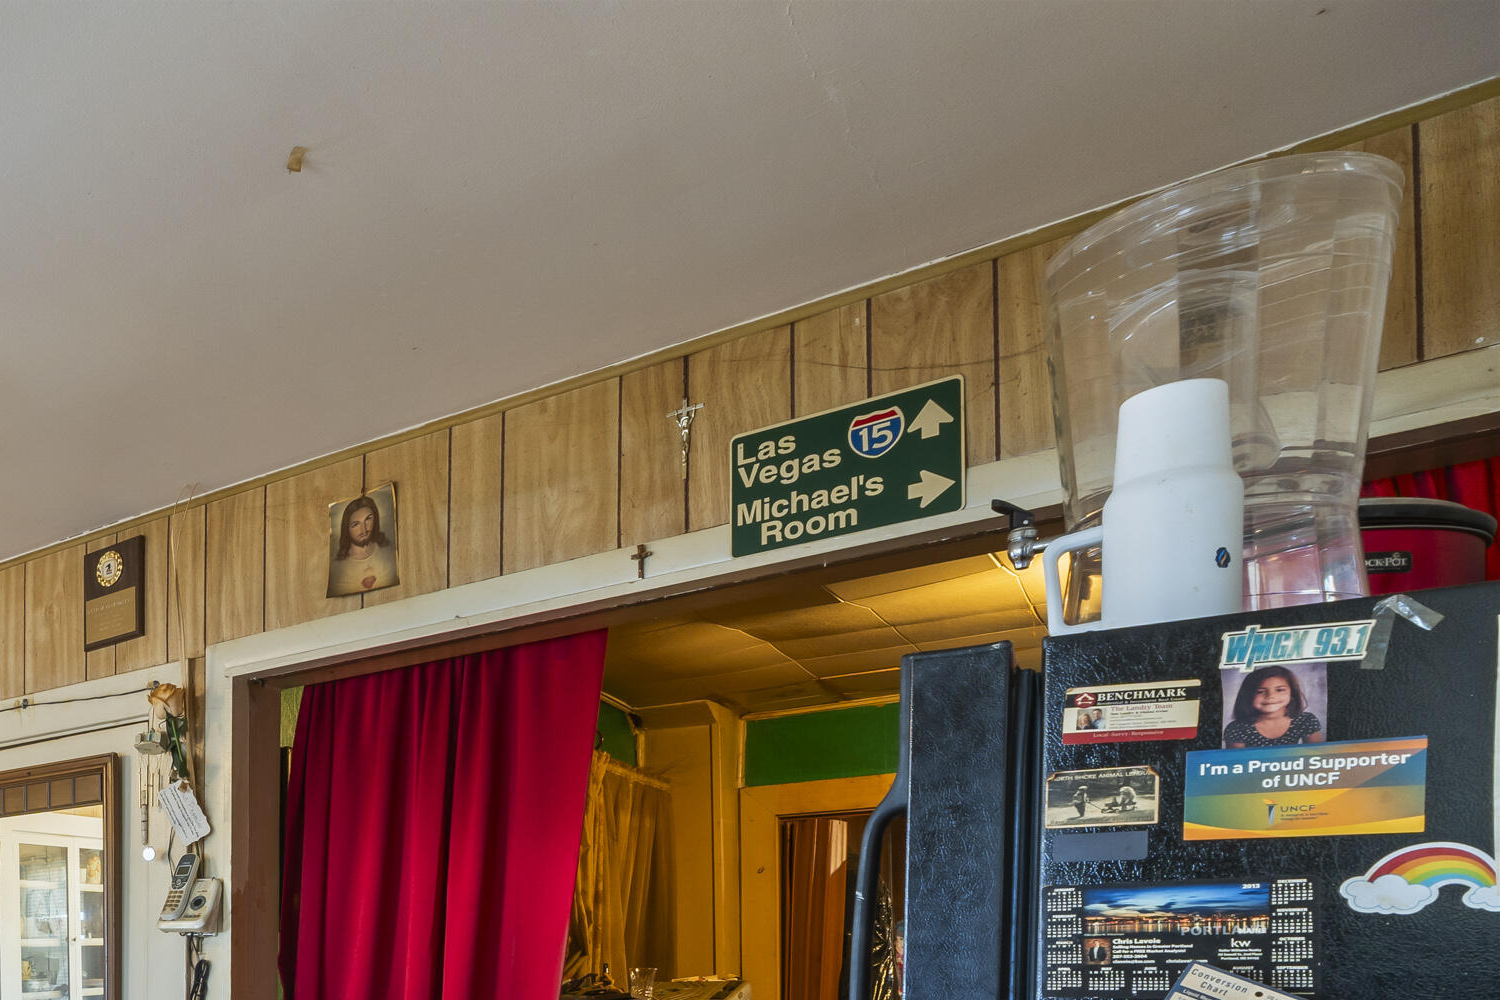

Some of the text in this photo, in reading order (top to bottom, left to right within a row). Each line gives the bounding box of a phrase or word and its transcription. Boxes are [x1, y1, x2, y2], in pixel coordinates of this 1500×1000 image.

[859, 421, 894, 452] 15
[737, 435, 797, 466] Las
[738, 448, 842, 488] Vegas
[737, 475, 885, 526] Michael's
[760, 508, 858, 546] Room
[1226, 625, 1370, 670] WMGX 93.1
[1097, 687, 1187, 702] BENCHMARK
[1126, 704, 1152, 712] Landry
[1200, 753, 1412, 776] I'm a Proud Supporter
[1262, 771, 1341, 789] of UNCF
[1280, 804, 1316, 813] UNCF
[1230, 938, 1251, 948] kw
[1191, 968, 1248, 993] Conversion
[1200, 981, 1228, 997] Chart
